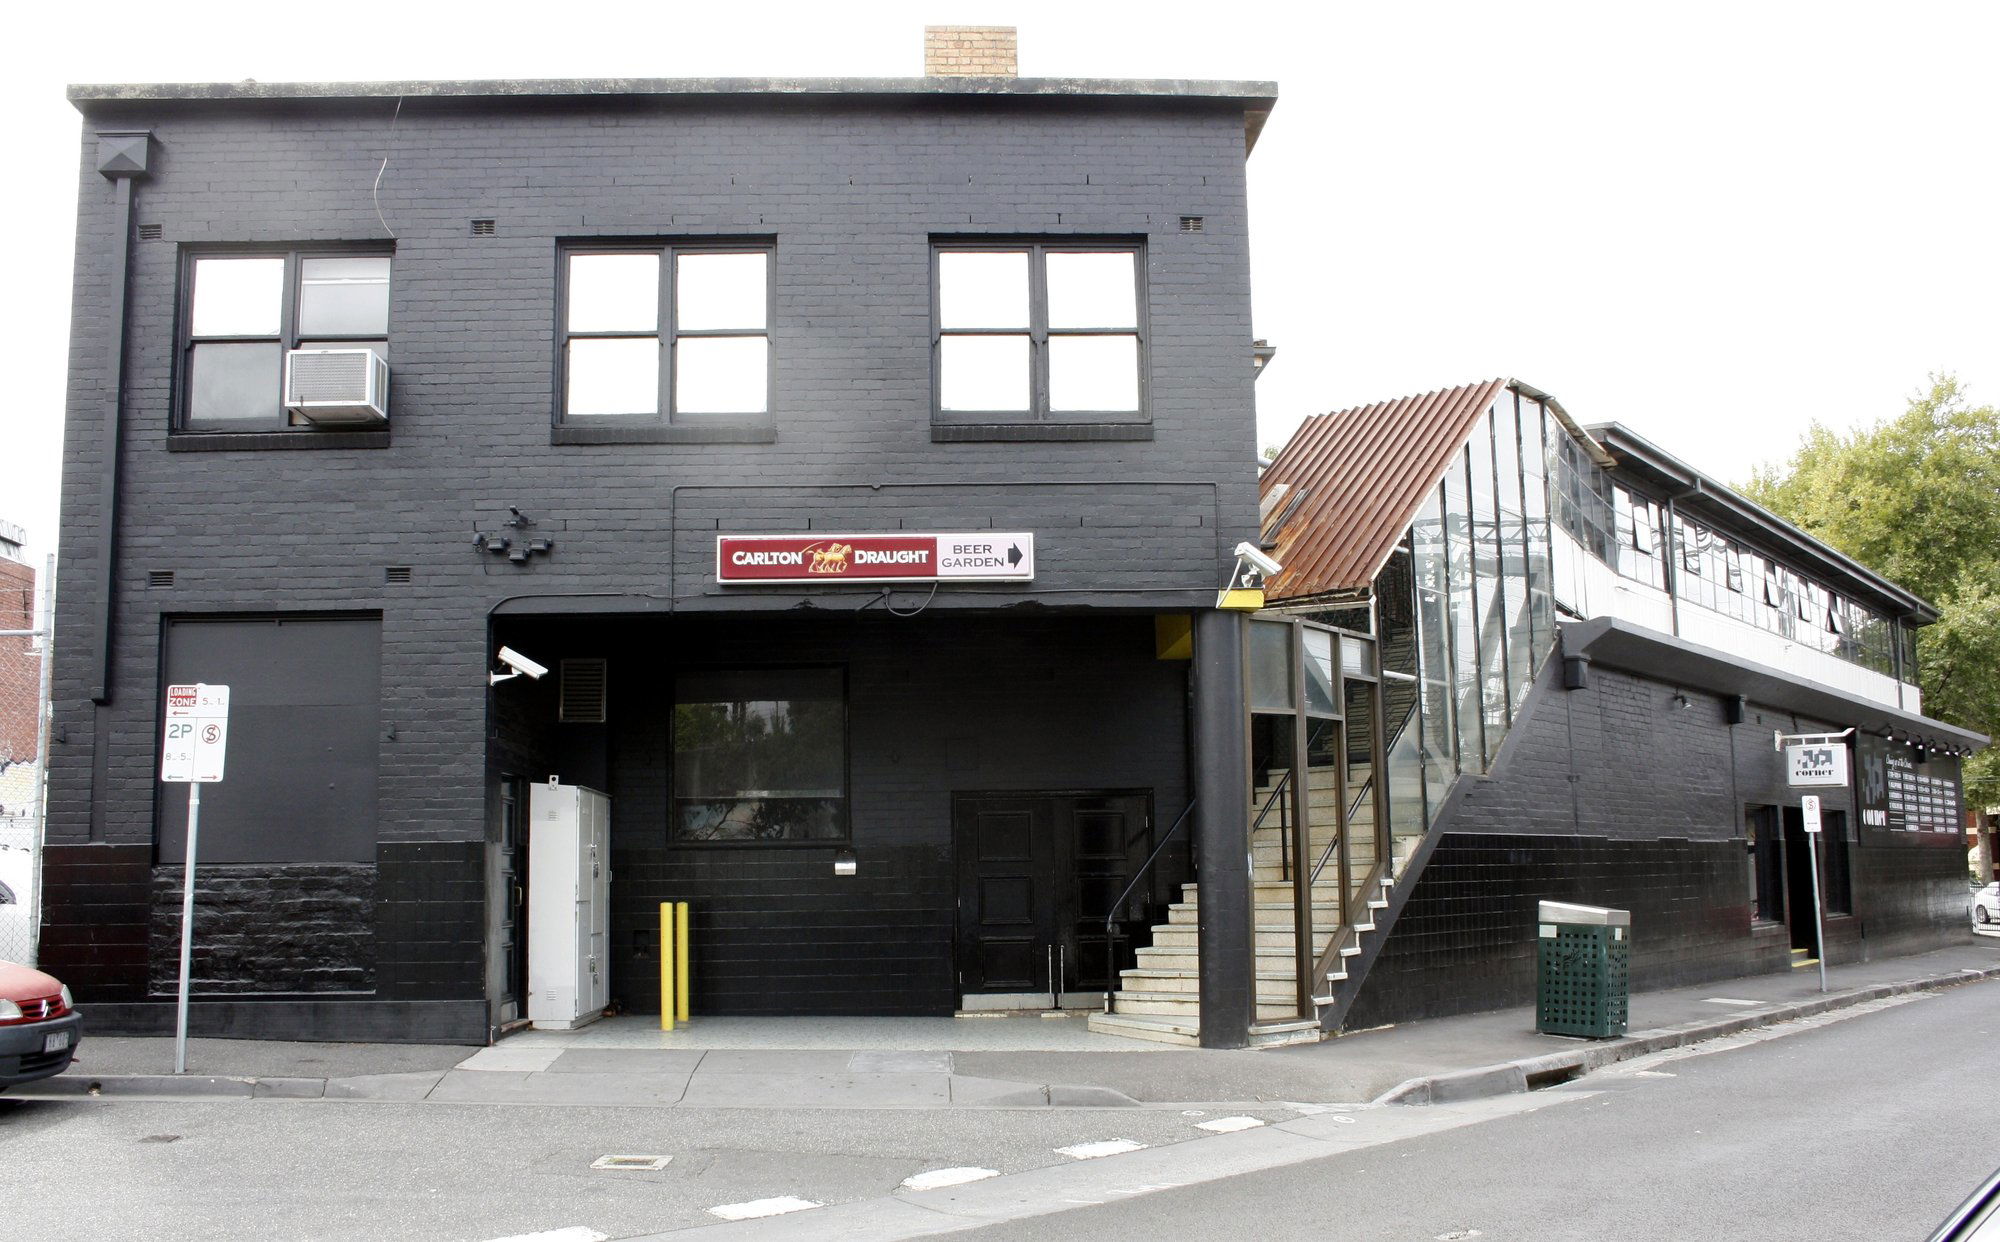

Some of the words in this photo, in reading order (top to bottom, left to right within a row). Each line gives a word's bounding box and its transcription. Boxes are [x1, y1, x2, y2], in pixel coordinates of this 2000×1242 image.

[953, 544, 992, 554] BEER
[732, 551, 803, 565] CARLTON
[854, 550, 929, 564] DRAUGHT
[941, 557, 1004, 568] GARDEN
[169, 687, 196, 697] LOADING
[169, 697, 196, 707] ZONE
[168, 723, 193, 739] 2P
[1795, 769, 1834, 777] corner
